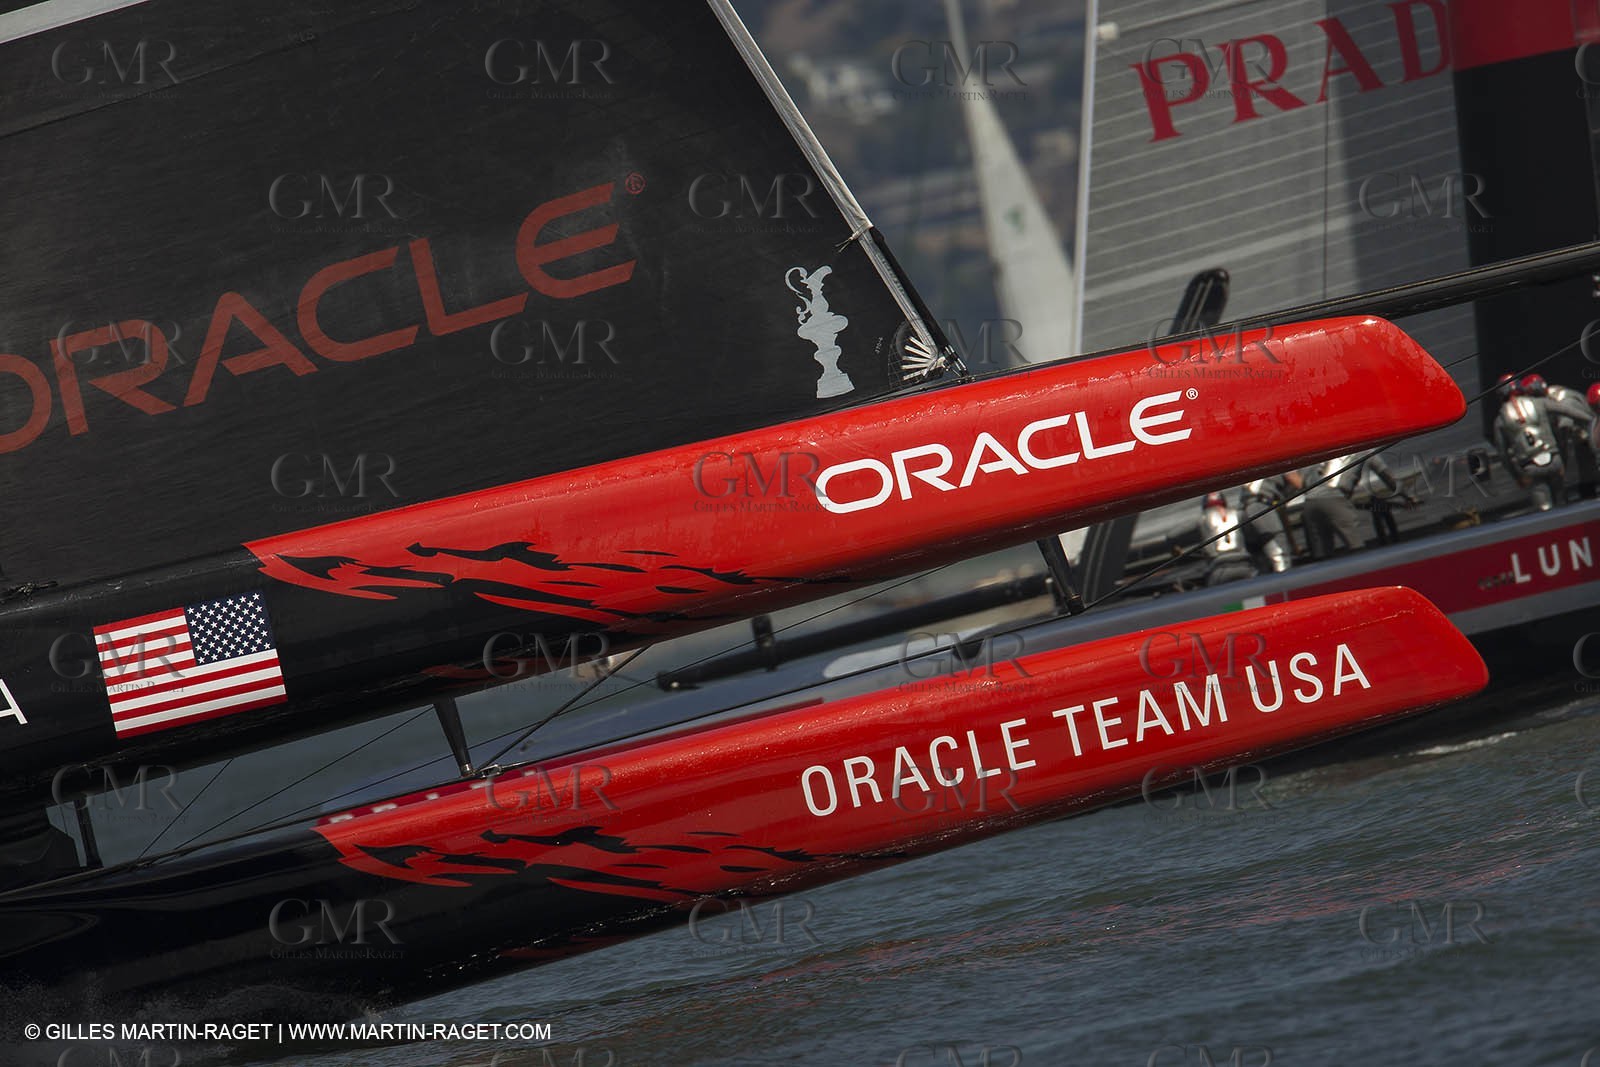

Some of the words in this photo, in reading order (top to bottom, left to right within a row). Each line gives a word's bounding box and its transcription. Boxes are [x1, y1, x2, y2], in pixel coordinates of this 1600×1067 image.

[1510, 536, 1593, 584] LUN
[800, 718, 1037, 817] ORACLE
[1052, 673, 1227, 757] TEAM
[1245, 643, 1373, 713] USA
